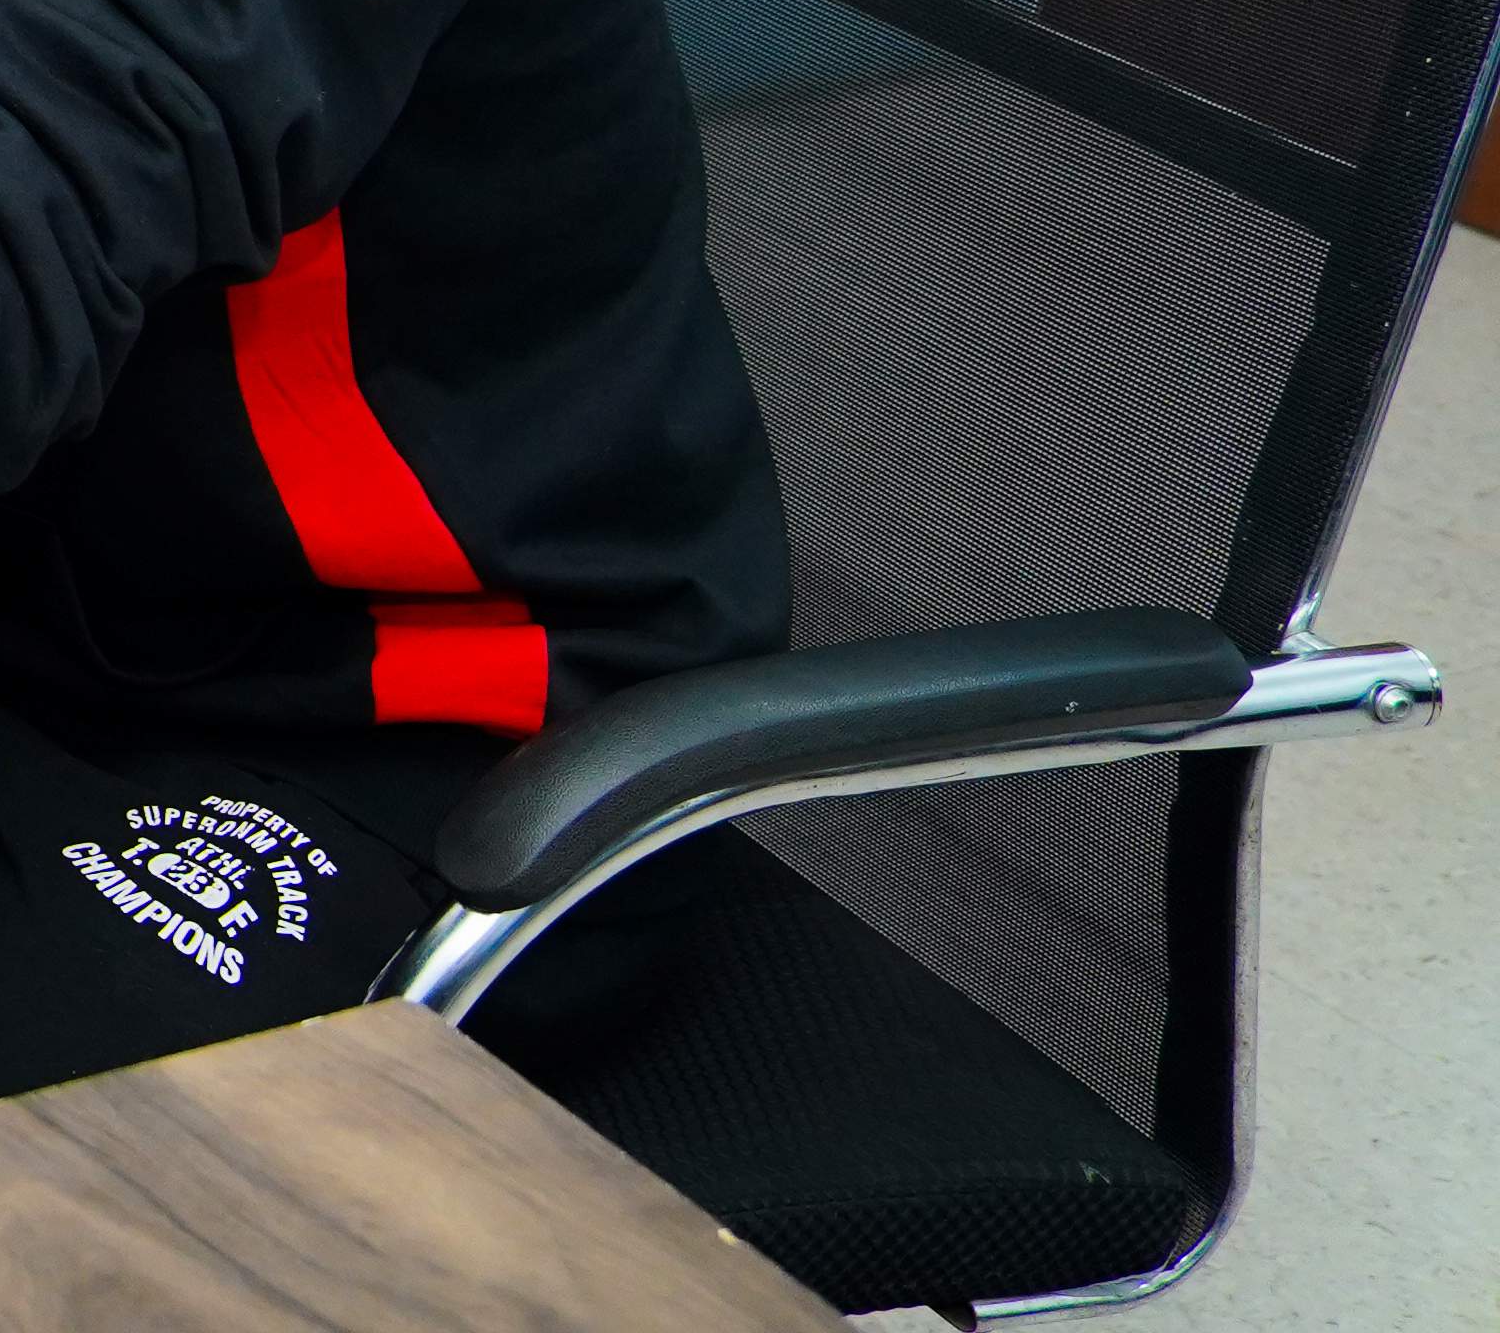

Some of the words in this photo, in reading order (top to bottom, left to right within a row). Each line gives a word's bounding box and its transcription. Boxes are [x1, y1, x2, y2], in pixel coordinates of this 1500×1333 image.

[201, 795, 311, 848] PROPERTY
[307, 848, 338, 876] OF
[62, 842, 244, 984] CHAMPIONS
[267, 855, 309, 941] TRACK
